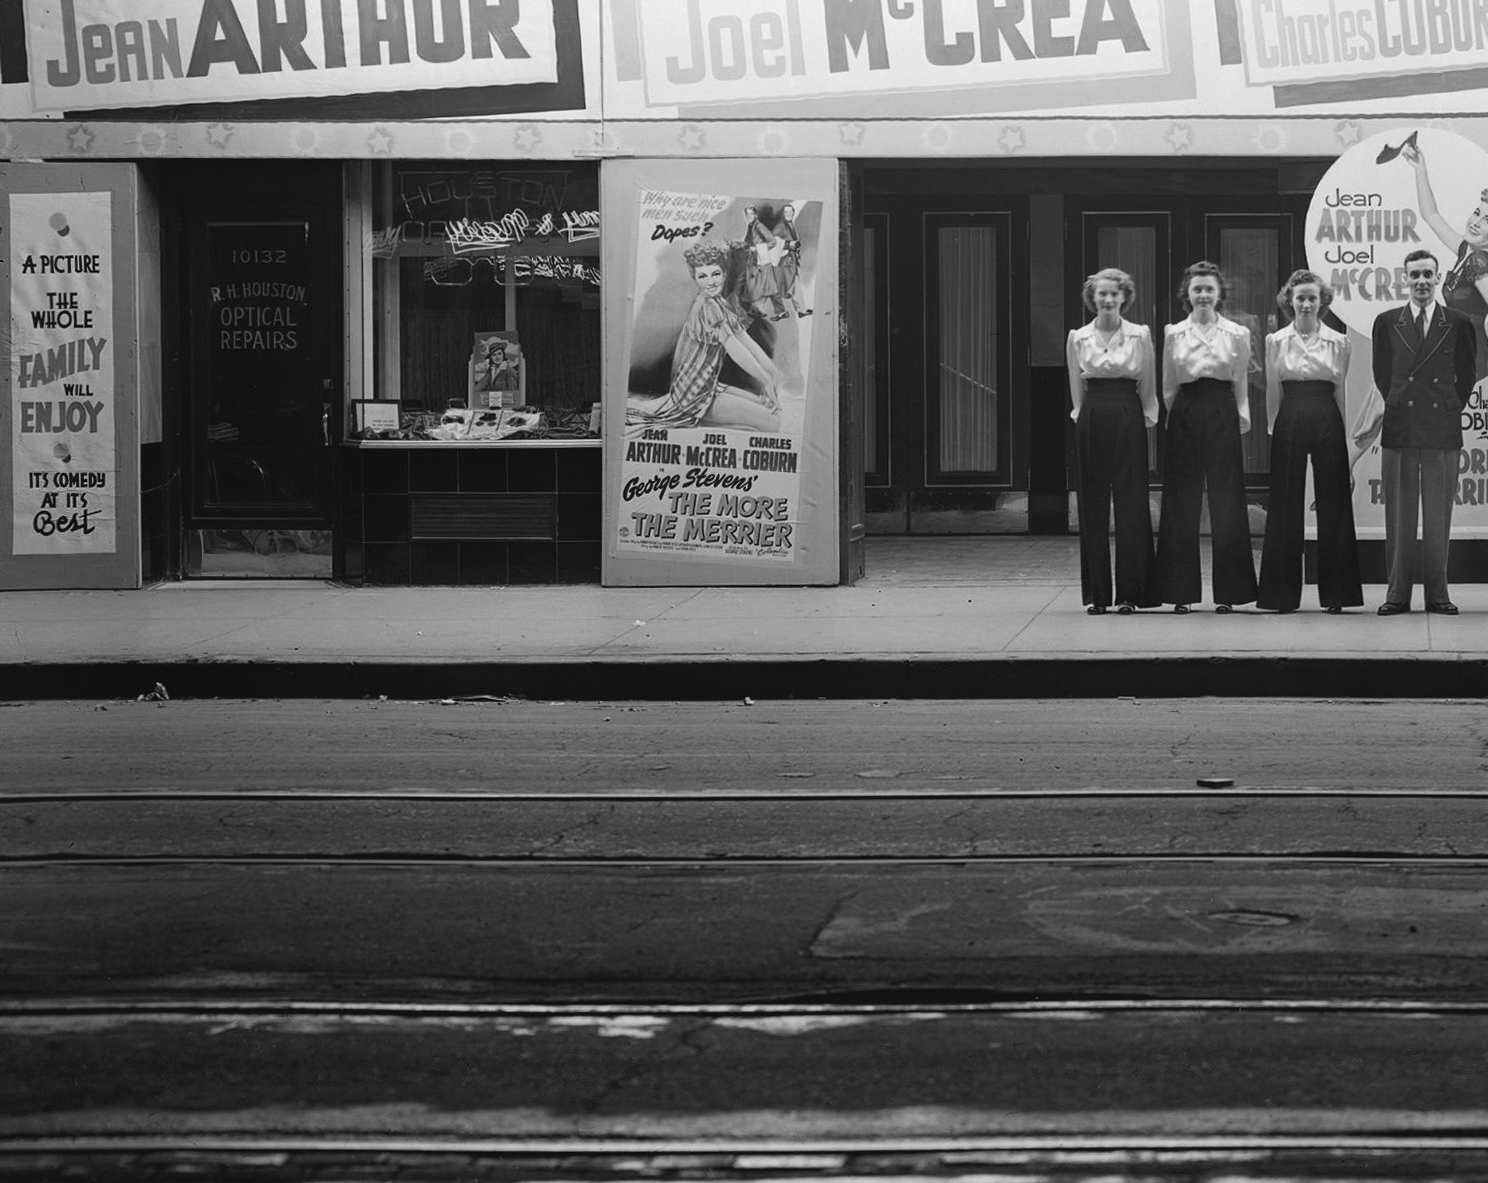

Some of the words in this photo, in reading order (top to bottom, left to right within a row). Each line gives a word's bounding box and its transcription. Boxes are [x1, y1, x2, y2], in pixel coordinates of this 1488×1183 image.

[642, 191, 669, 210] Why
[673, 197, 696, 207] are
[1325, 188, 1383, 208] Jean
[651, 221, 714, 244] Dopes?
[1315, 208, 1422, 244] ARTHUR
[22, 255, 37, 274] A
[40, 255, 101, 274] PICTURE
[232, 249, 287, 263] 10132
[1324, 245, 1374, 265] Joel
[1330, 267, 1411, 303] McCRE
[46, 292, 79, 310] THE
[31, 310, 93, 329] WHOLE
[220, 306, 298, 327] OPTICAL
[220, 330, 298, 351] REPAIRS
[18, 336, 108, 389] FAMILY
[63, 384, 94, 397] WILL
[20, 400, 105, 433] ENJOY
[642, 429, 668, 442] JEAN
[703, 433, 728, 446] JOEL
[749, 435, 792, 451] CHARLES
[625, 441, 682, 465] ARTHUR
[742, 450, 798, 473] COBURN
[53, 472, 106, 488] COMEDY
[622, 473, 681, 502] George
[40, 492, 59, 510] AT
[668, 492, 712, 517] THE
[716, 494, 789, 522] MORE
[33, 509, 103, 536] Best
[631, 511, 678, 539] THE
[682, 517, 793, 549] MERRIER
